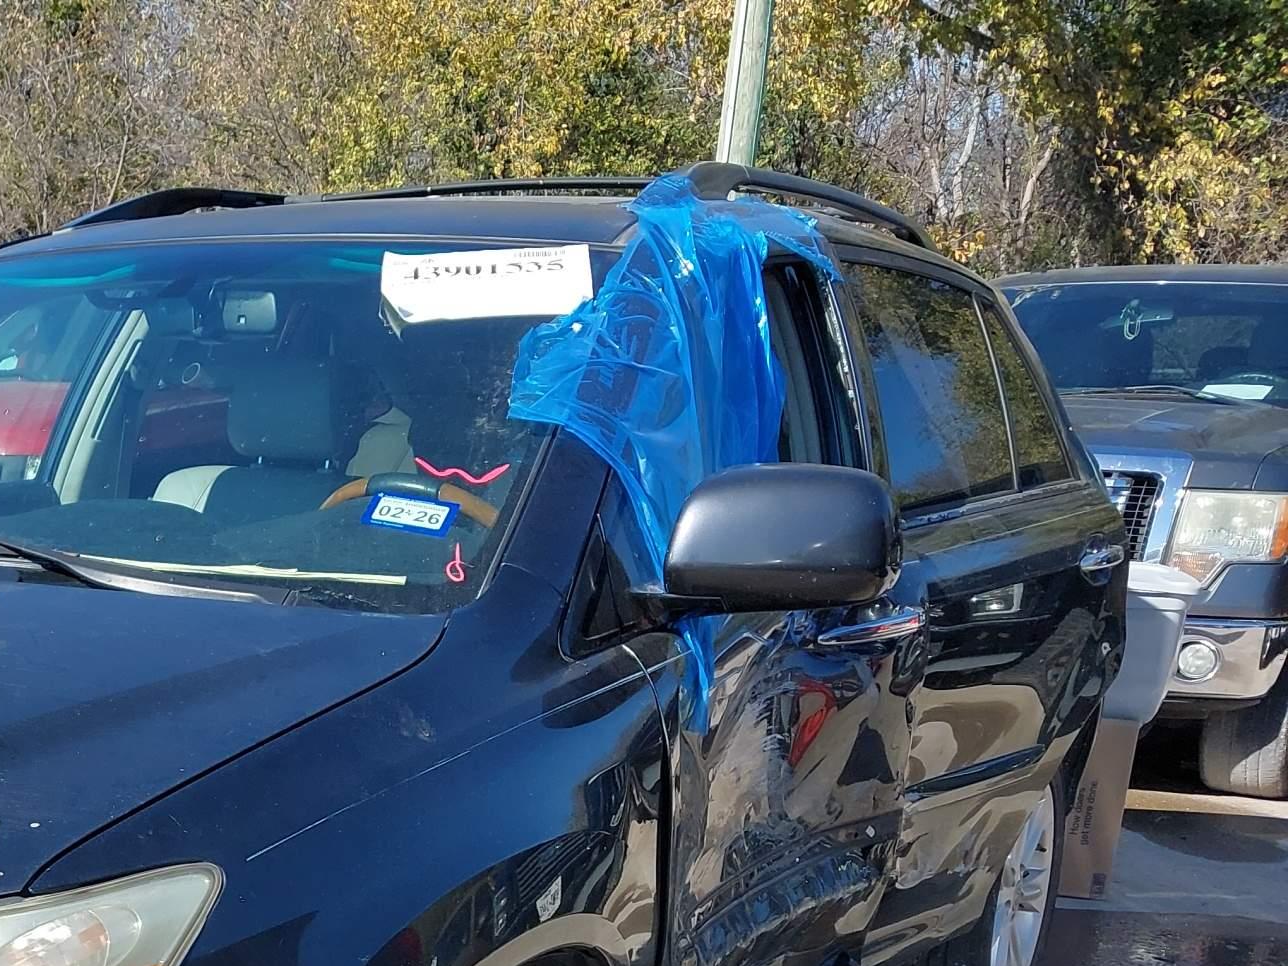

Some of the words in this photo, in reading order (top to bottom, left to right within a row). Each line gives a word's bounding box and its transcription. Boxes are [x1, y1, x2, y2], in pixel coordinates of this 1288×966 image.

[378, 505, 405, 519] 02
[413, 510, 441, 525] 26
[1069, 816, 1081, 836] How
[1083, 806, 1094, 829] more
[1080, 831, 1089, 846] get
